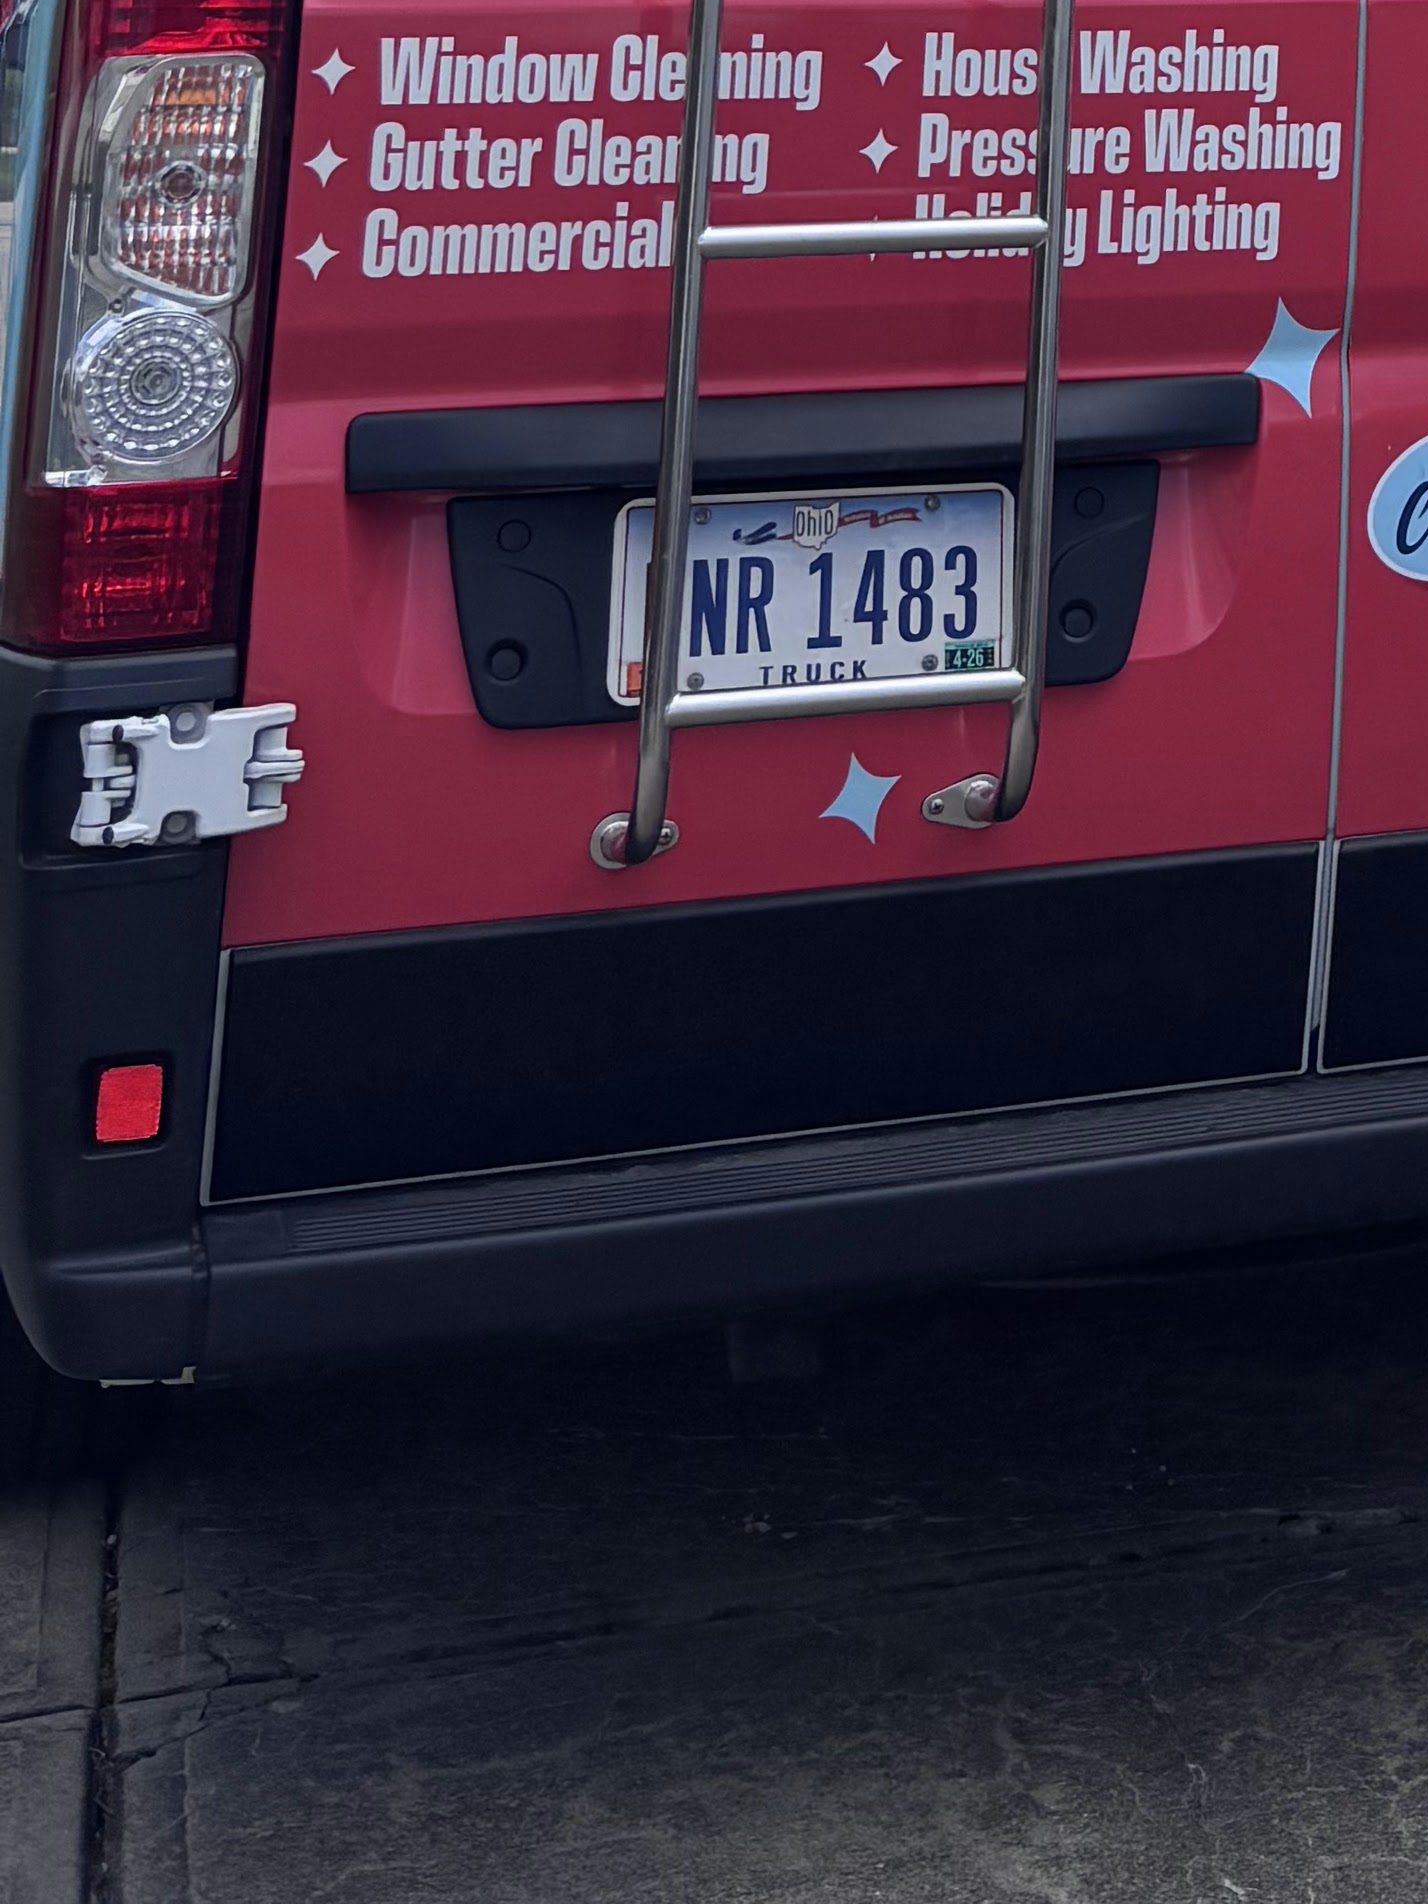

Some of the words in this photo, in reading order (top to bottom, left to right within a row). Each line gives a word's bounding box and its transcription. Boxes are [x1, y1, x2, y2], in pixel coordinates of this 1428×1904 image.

[379, 35, 600, 106] Window
[610, 33, 823, 111] Clening
[922, 31, 1040, 97] Hous
[1079, 28, 1280, 103] Washing
[369, 121, 542, 192] Gutter
[553, 118, 770, 195] Cleanng
[1143, 106, 1342, 180] Washing
[362, 201, 676, 278] Commercial
[1097, 187, 1281, 265] Lighting
[689, 556, 774, 657] NR
[806, 545, 978, 649] 1483
[758, 659, 868, 686] TRUCK
[953, 648, 984, 668] 4-26
